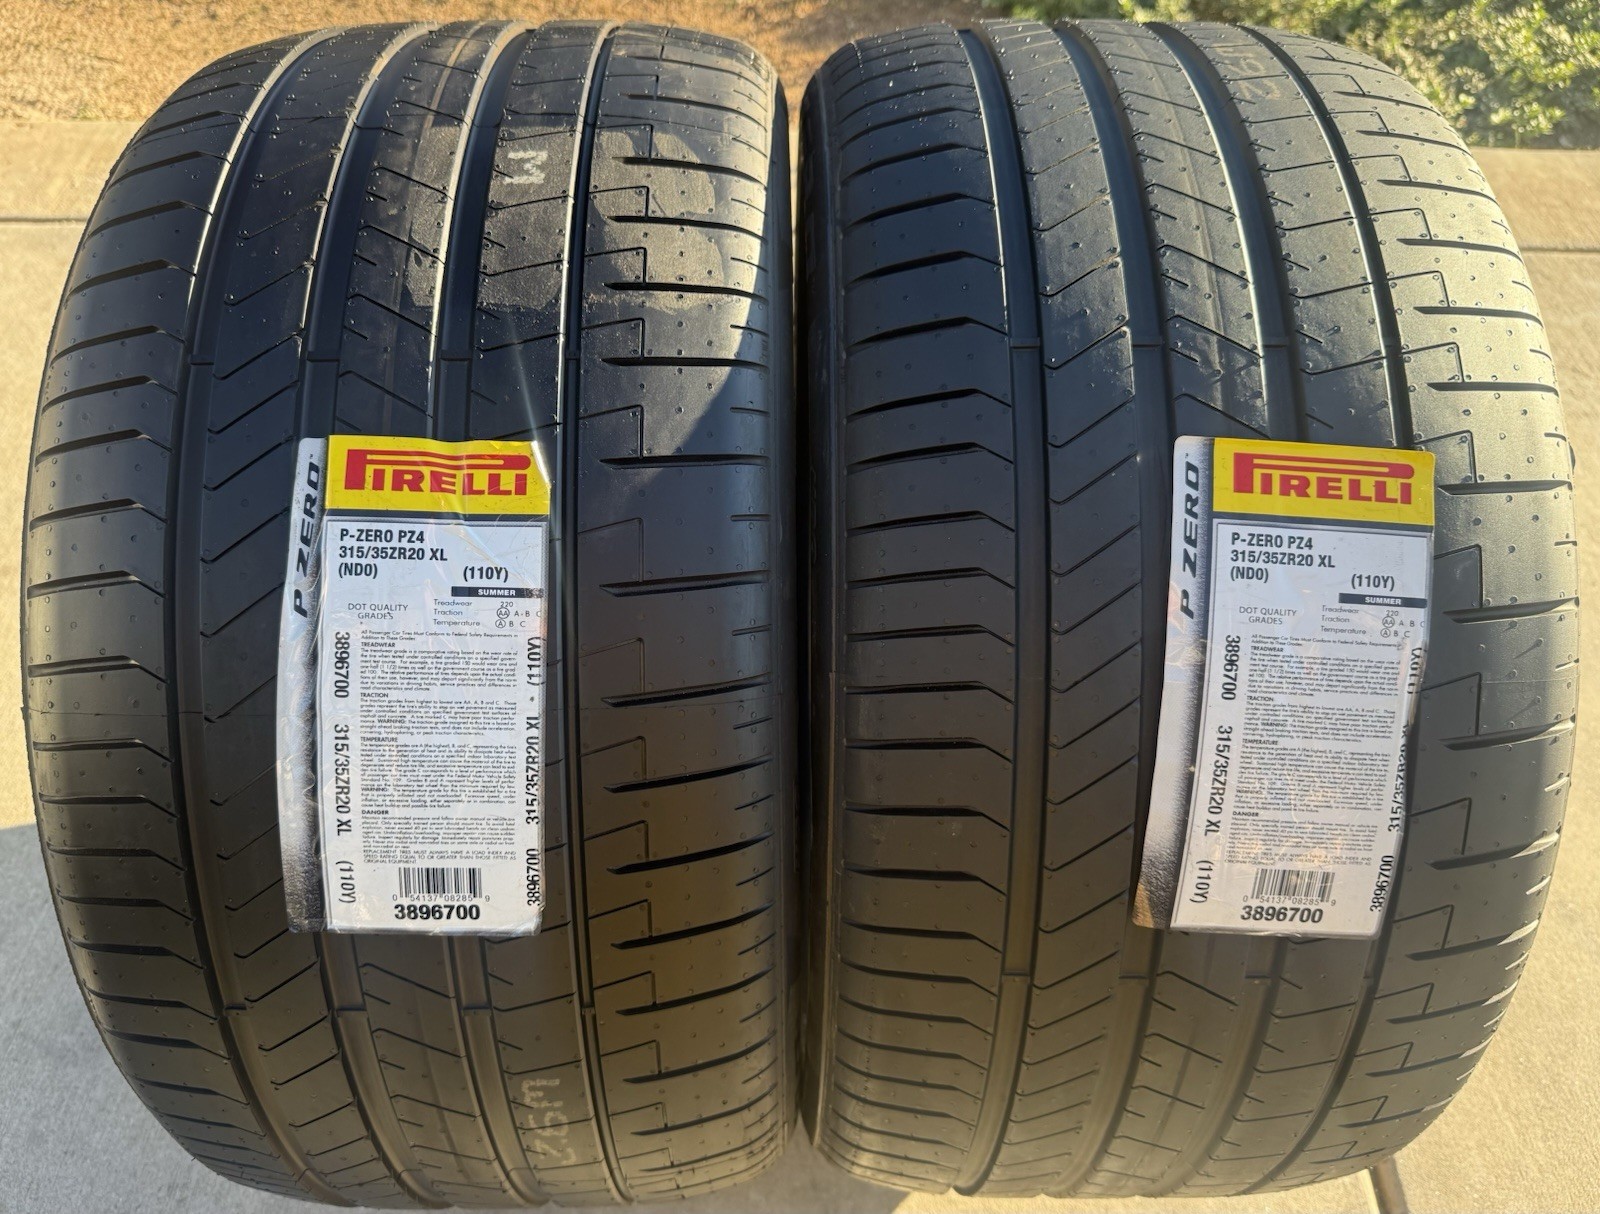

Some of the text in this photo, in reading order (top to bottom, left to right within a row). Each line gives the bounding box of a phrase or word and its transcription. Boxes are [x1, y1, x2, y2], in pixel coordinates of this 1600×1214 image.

[344, 449, 532, 496] PIRELLI
[1234, 452, 1414, 504] PIRELLI
[340, 528, 425, 544] P-ZERO PZ4
[1231, 532, 1313, 550] P-ZERO PZ4
[339, 546, 448, 561] 315/35ZR20 XL
[1230, 550, 1336, 568] 315/35ZR20 XL
[463, 566, 508, 582] (110Y)
[1351, 574, 1395, 592] (110Y)
[294, 588, 308, 618] P
[348, 603, 408, 612] DOT QUALITY
[1180, 589, 1195, 620] P
[1322, 605, 1360, 614] Treadwear
[1365, 596, 1401, 605] SUMMER
[1239, 606, 1297, 618] DOT QUALITY
[1248, 616, 1283, 625] GRADES
[1321, 626, 1366, 635] Temperature
[527, 636, 546, 686] (110Y)
[334, 632, 355, 903] 3896700 315/35ZR20 XL (110Y)
[1189, 634, 1241, 903] 3896700 315/35ZR20 XL (110Y)
[526, 848, 540, 906] 3896700
[1370, 855, 1394, 912] 3896700
[394, 904, 480, 920] 3896700
[1241, 905, 1323, 923] 3896700
